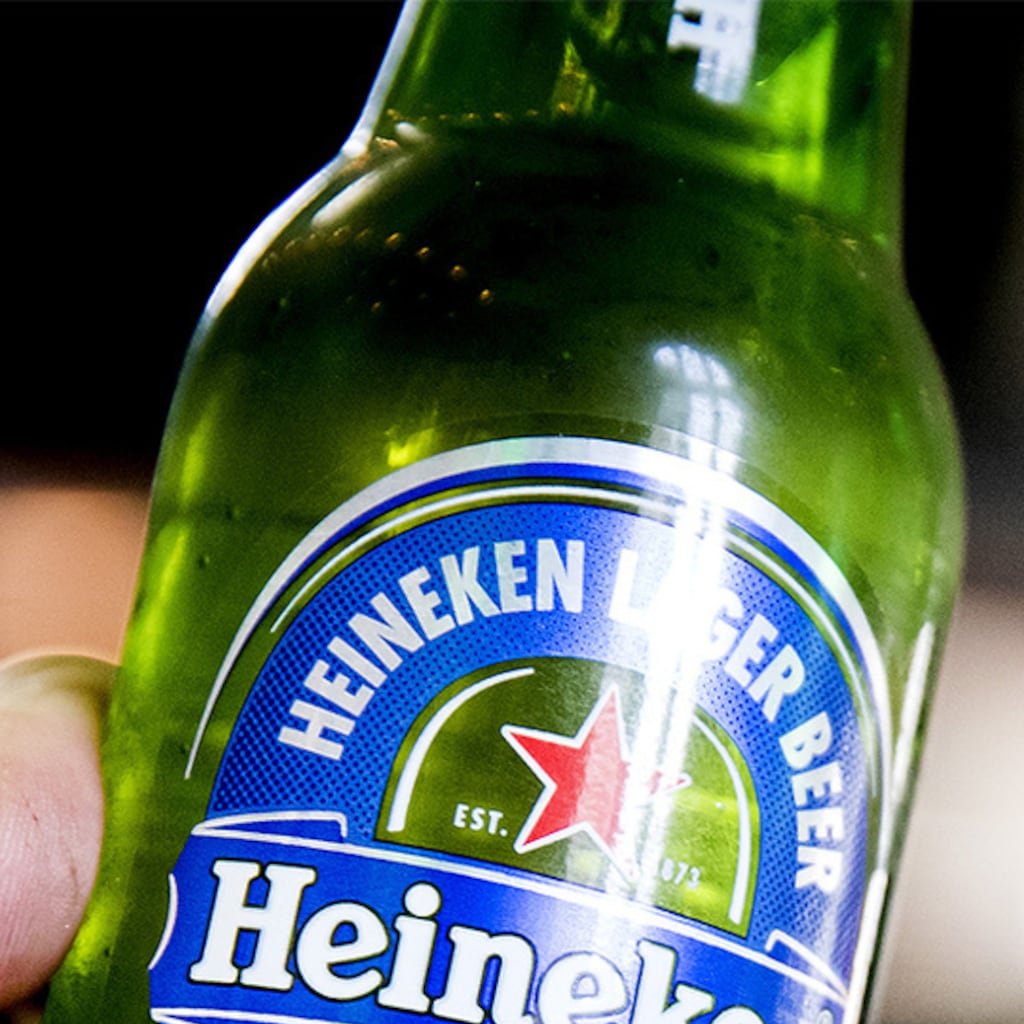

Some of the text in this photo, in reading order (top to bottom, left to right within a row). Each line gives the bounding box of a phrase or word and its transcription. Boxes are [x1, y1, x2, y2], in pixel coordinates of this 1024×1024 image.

[278, 538, 844, 894] HEINEKEN LGER BEER
[453, 803, 508, 837] EST.
